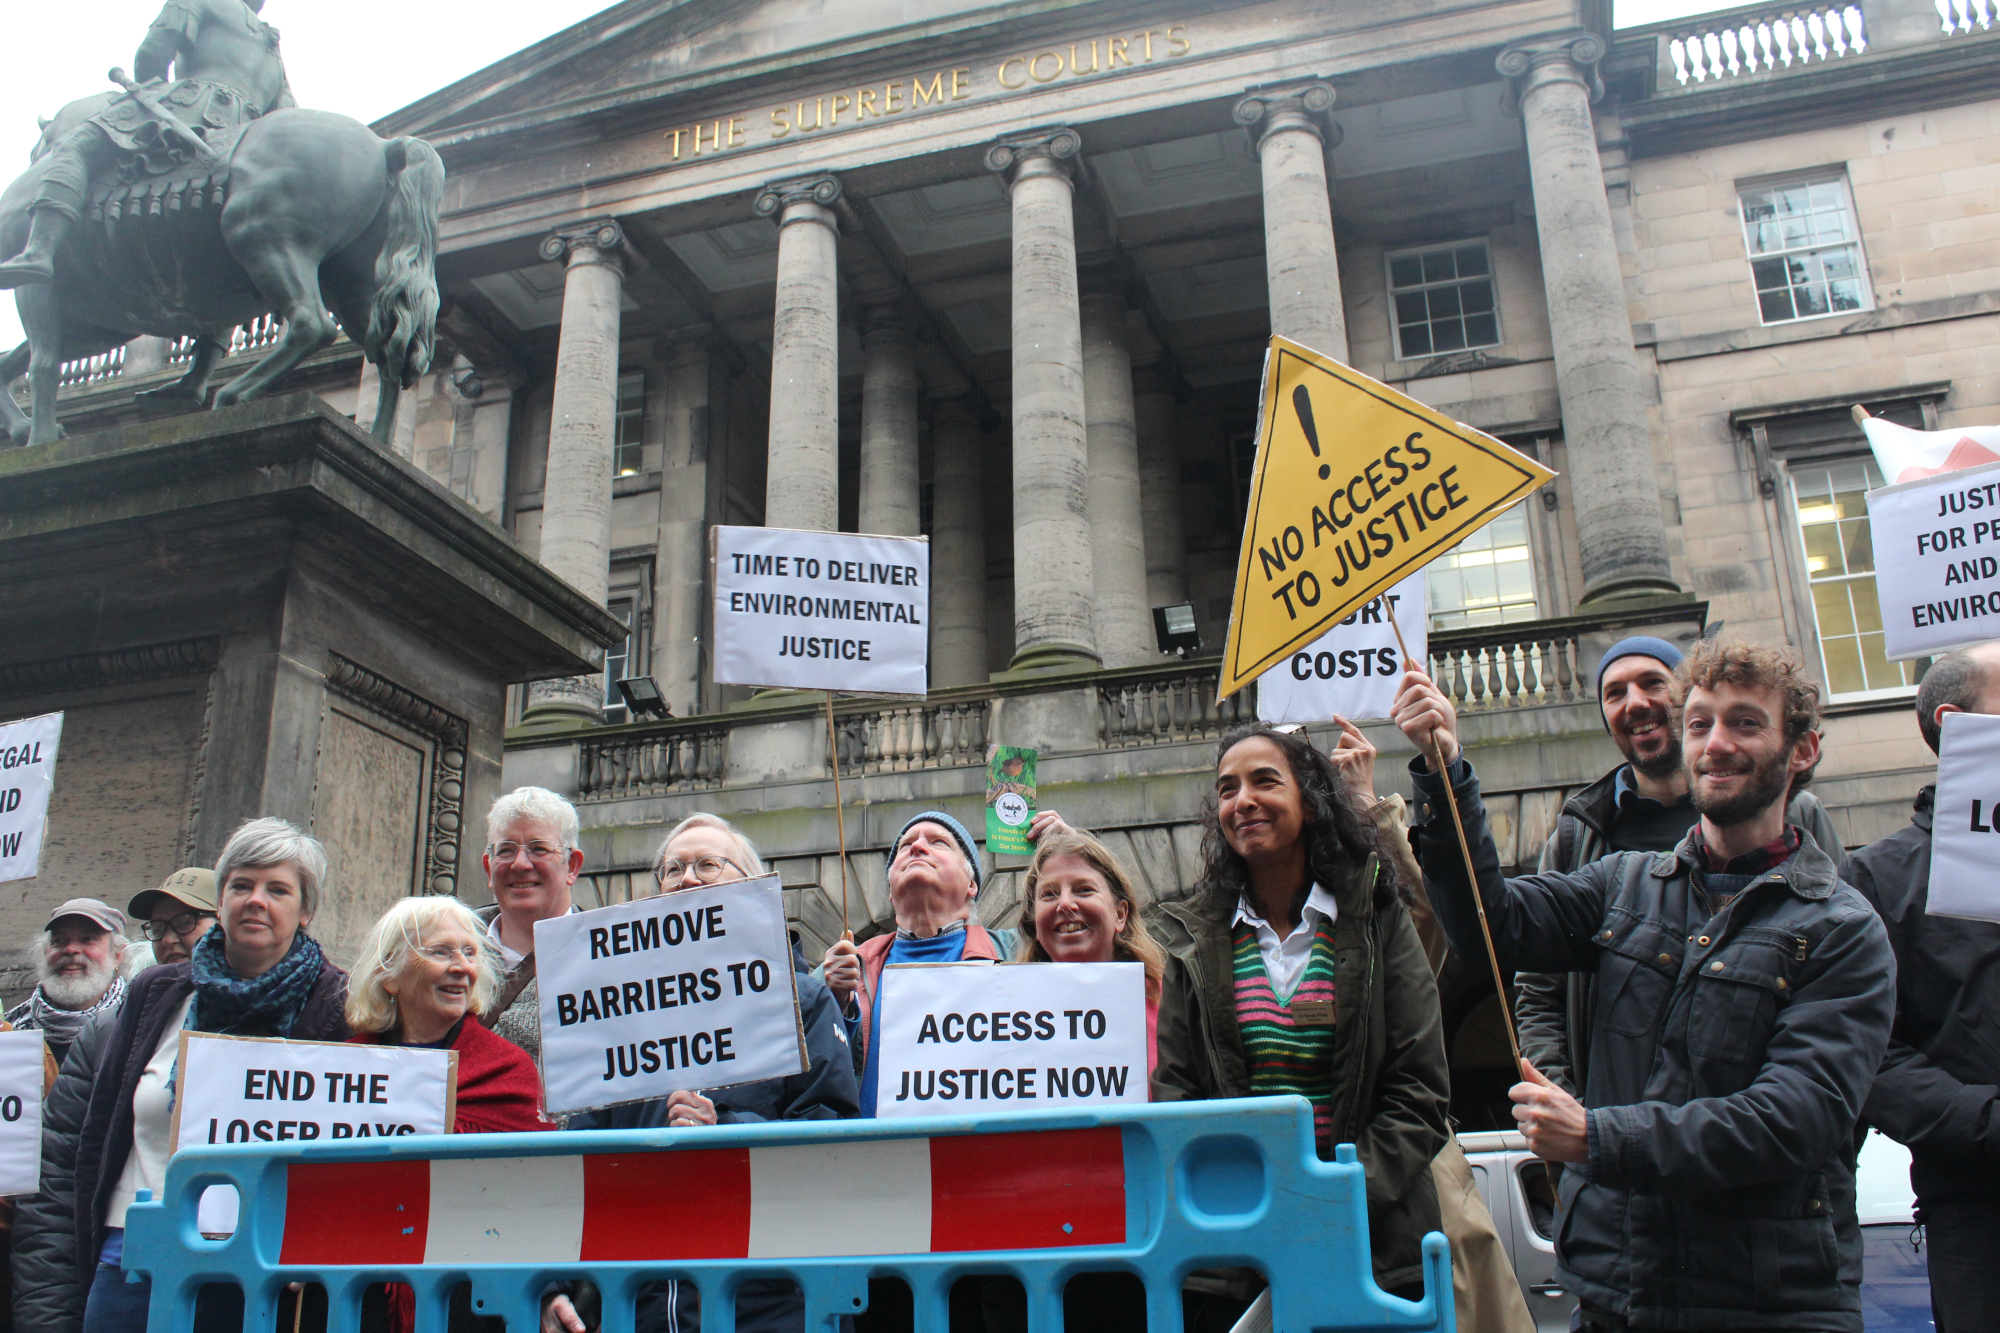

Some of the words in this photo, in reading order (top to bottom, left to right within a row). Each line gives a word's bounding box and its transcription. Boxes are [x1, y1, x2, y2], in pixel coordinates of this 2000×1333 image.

[664, 116, 746, 160] THE
[771, 67, 971, 138] SUPREME
[998, 24, 1191, 88] COURTS
[1258, 526, 1304, 581] NO
[1311, 432, 1431, 548] ACCESS
[1272, 570, 1321, 620] TO
[1331, 465, 1469, 587] JUSTICE
[1917, 526, 1967, 556] FOR
[1973, 518, 2000, 544] PE
[732, 553, 788, 576] TIME
[794, 557, 819, 579] TO
[828, 560, 918, 586] DELIVER
[1945, 556, 1998, 586] AND
[731, 592, 920, 624] ENVIRONMENTAL
[1912, 591, 2000, 628] ENVIRO
[779, 636, 870, 661] JUSTICE
[1291, 647, 1398, 681] COSTS
[0, 831, 23, 858] W
[590, 904, 726, 960] REMOVE
[557, 967, 722, 1027] BARRIERS
[727, 959, 770, 997] TO
[917, 1010, 1056, 1044] ACCESS
[1063, 1009, 1106, 1039] TO
[603, 1027, 736, 1081] JUSTICE
[244, 1069, 315, 1101] END
[324, 1072, 389, 1104] THE
[896, 1068, 1037, 1101] JUSTICE
[1047, 1066, 1129, 1098] NOW
